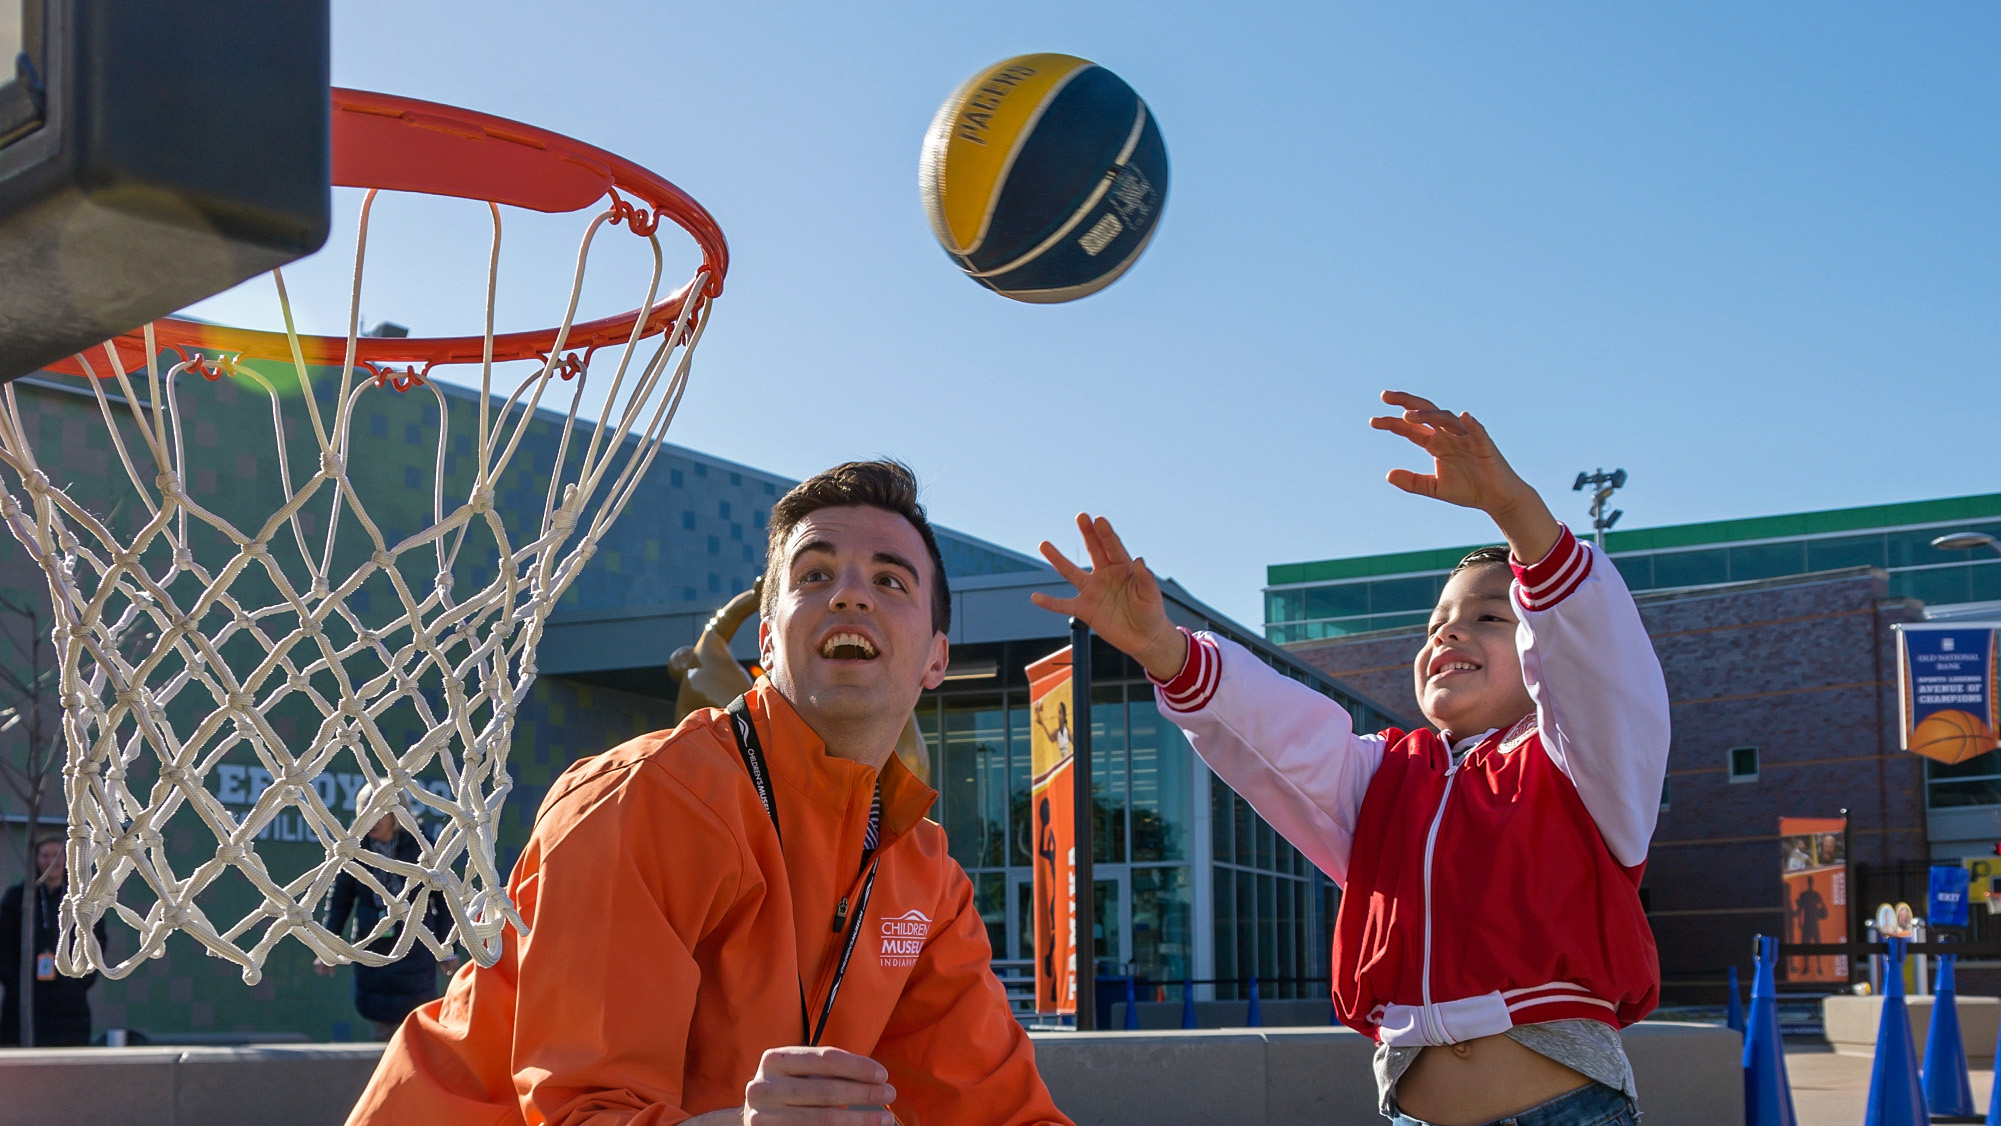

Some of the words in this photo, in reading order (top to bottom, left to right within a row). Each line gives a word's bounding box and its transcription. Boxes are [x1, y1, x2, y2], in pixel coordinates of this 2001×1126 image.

[958, 66, 1038, 146] PACERS
[1918, 654, 1937, 662] OLD
[1938, 653, 1981, 662] NATIONAL
[1936, 662, 1961, 670] BANK
[1919, 684, 1965, 693] AVENUE
[1966, 684, 1983, 692] OF
[1918, 694, 1983, 703] CHAMPIONS
[747, 748, 764, 785] CHILDREN'S
[1937, 892, 1961, 902] EXIT
[881, 939, 925, 954] MUSEU
